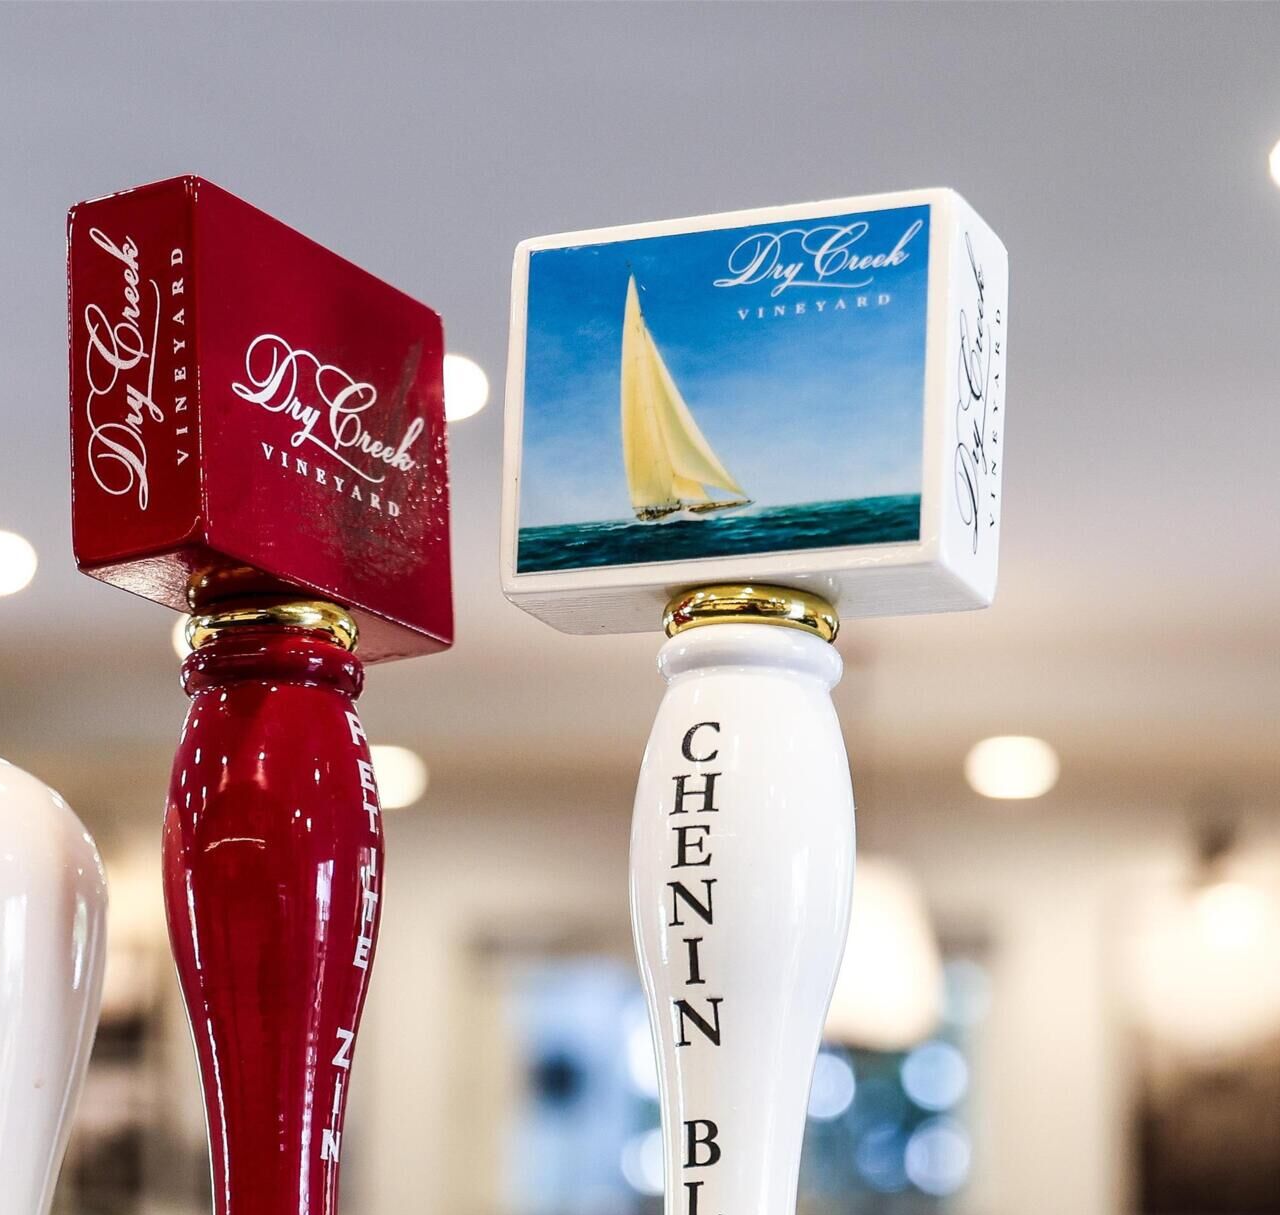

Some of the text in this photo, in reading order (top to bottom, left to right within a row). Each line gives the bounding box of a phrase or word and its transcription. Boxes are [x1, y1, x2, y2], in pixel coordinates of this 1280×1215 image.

[713, 219, 923, 297] Dry Creek
[738, 294, 892, 321] VINEYARD
[85, 228, 164, 510] Dry Creek
[170, 248, 190, 466] VINEYARD
[316, 364, 425, 471] Creek
[261, 442, 401, 517] VINEYARD
[668, 721, 724, 1048] CHENIN
[321, 1027, 355, 1163] ZIN
